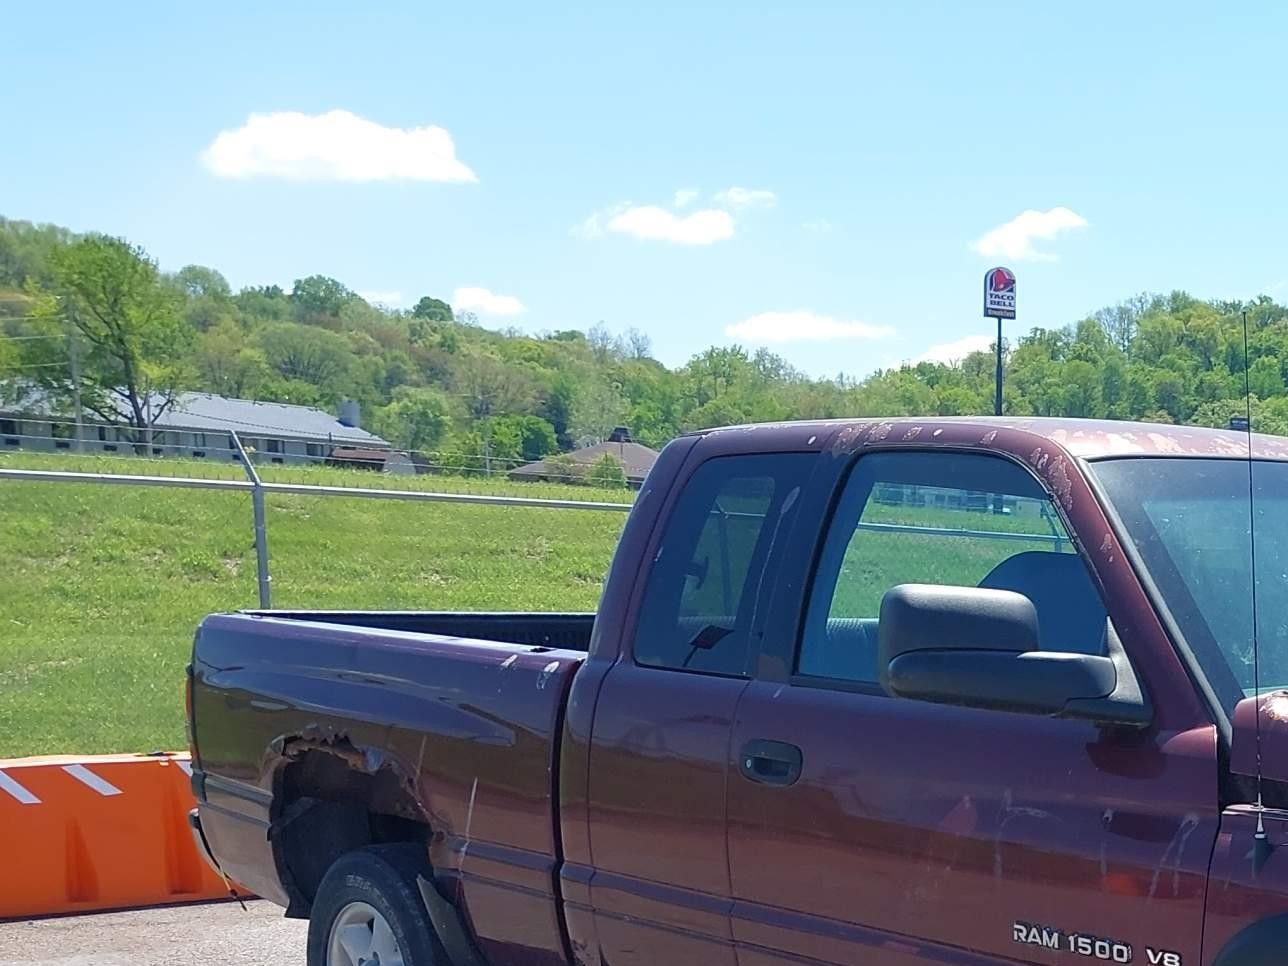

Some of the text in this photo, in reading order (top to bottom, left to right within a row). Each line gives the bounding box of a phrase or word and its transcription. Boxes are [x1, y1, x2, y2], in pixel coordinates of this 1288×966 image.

[990, 293, 1014, 301] TACO
[1013, 923, 1059, 949] RAM
[1068, 933, 1132, 963] 1500
